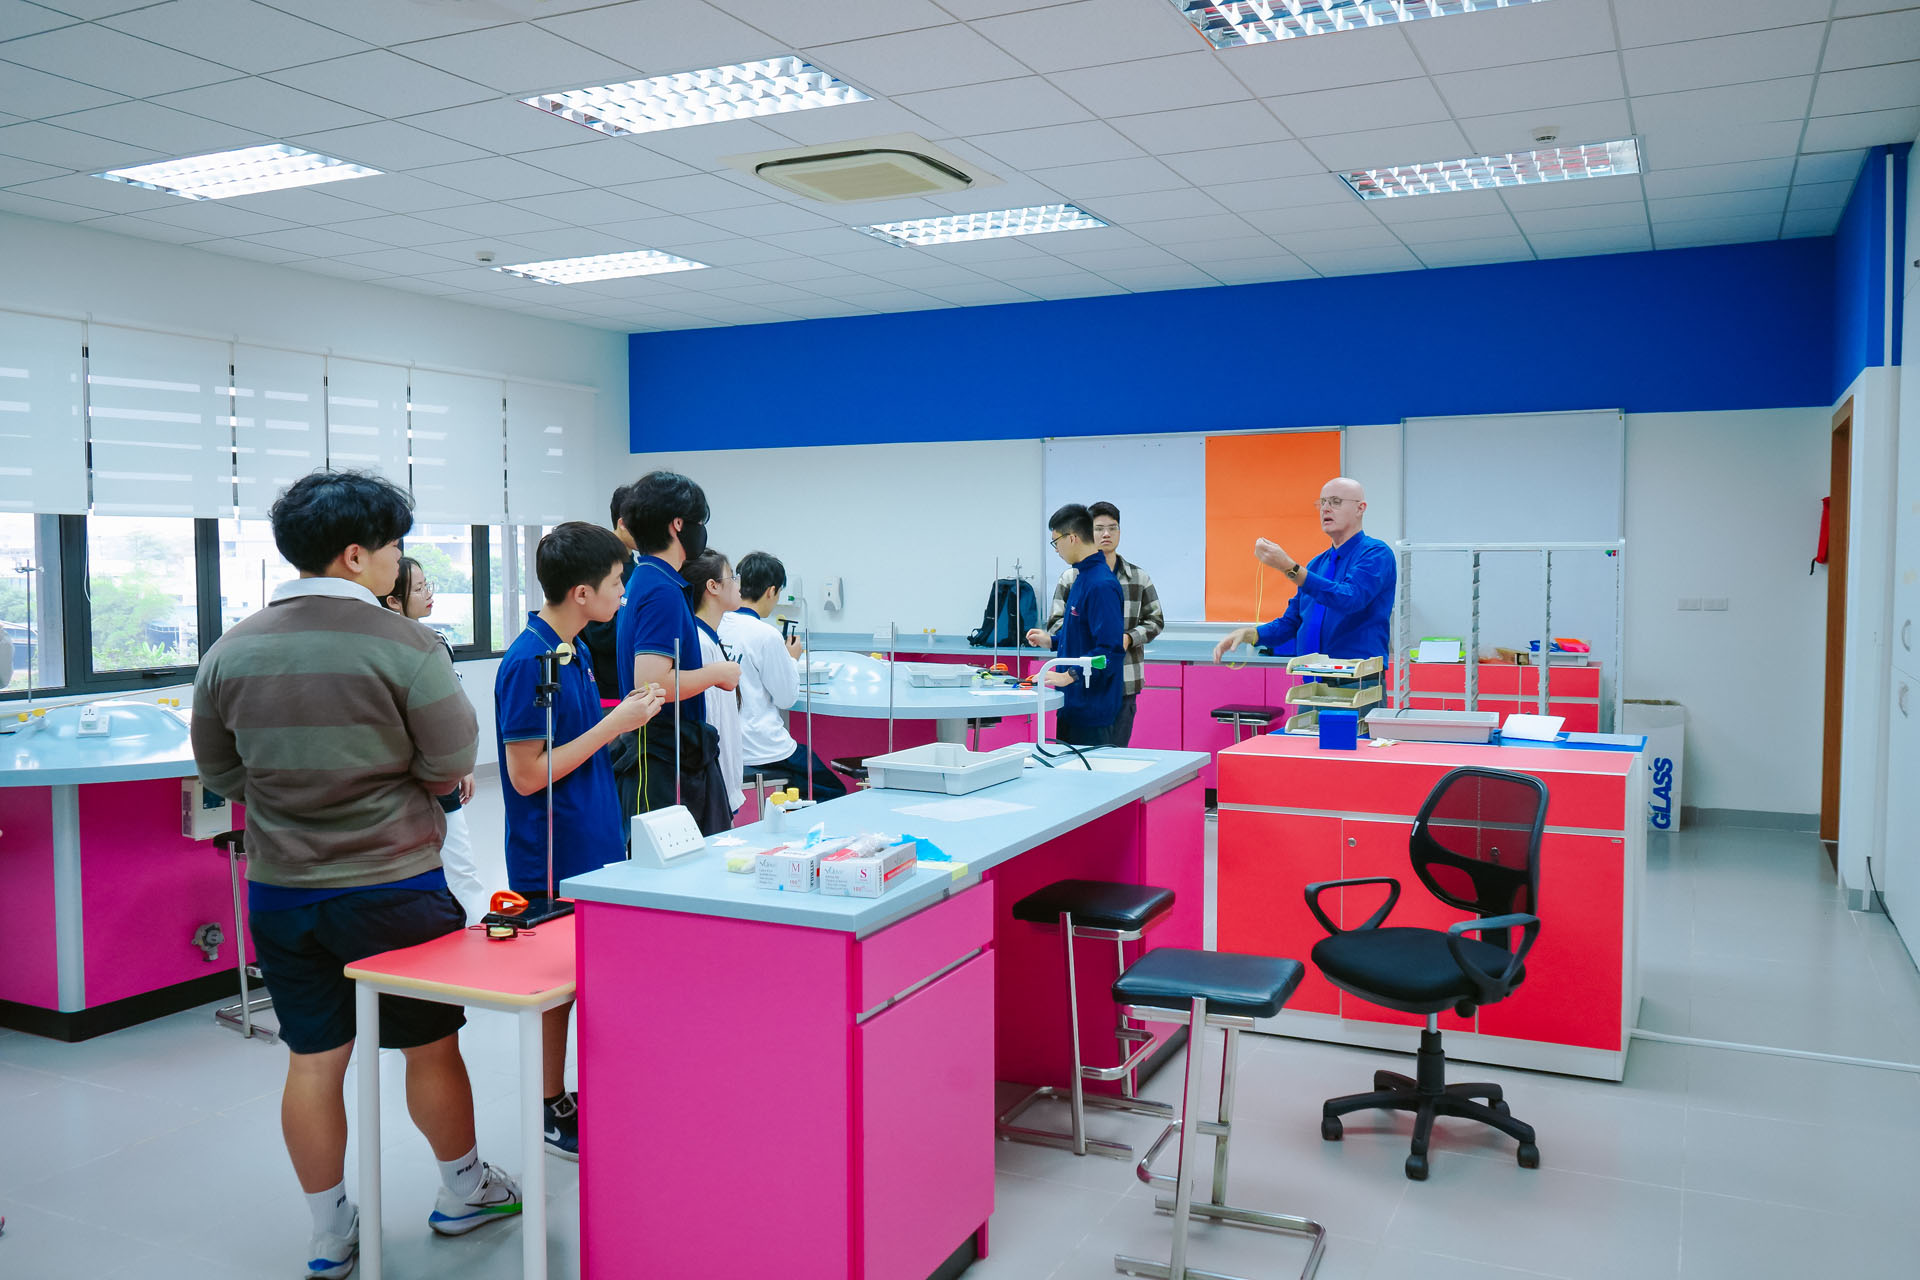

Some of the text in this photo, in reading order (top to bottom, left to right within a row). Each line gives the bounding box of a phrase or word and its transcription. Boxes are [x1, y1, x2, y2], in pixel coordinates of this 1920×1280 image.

[1651, 757, 1674, 829] GLASS
[792, 863, 800, 873] M
[860, 868, 867, 879] S
